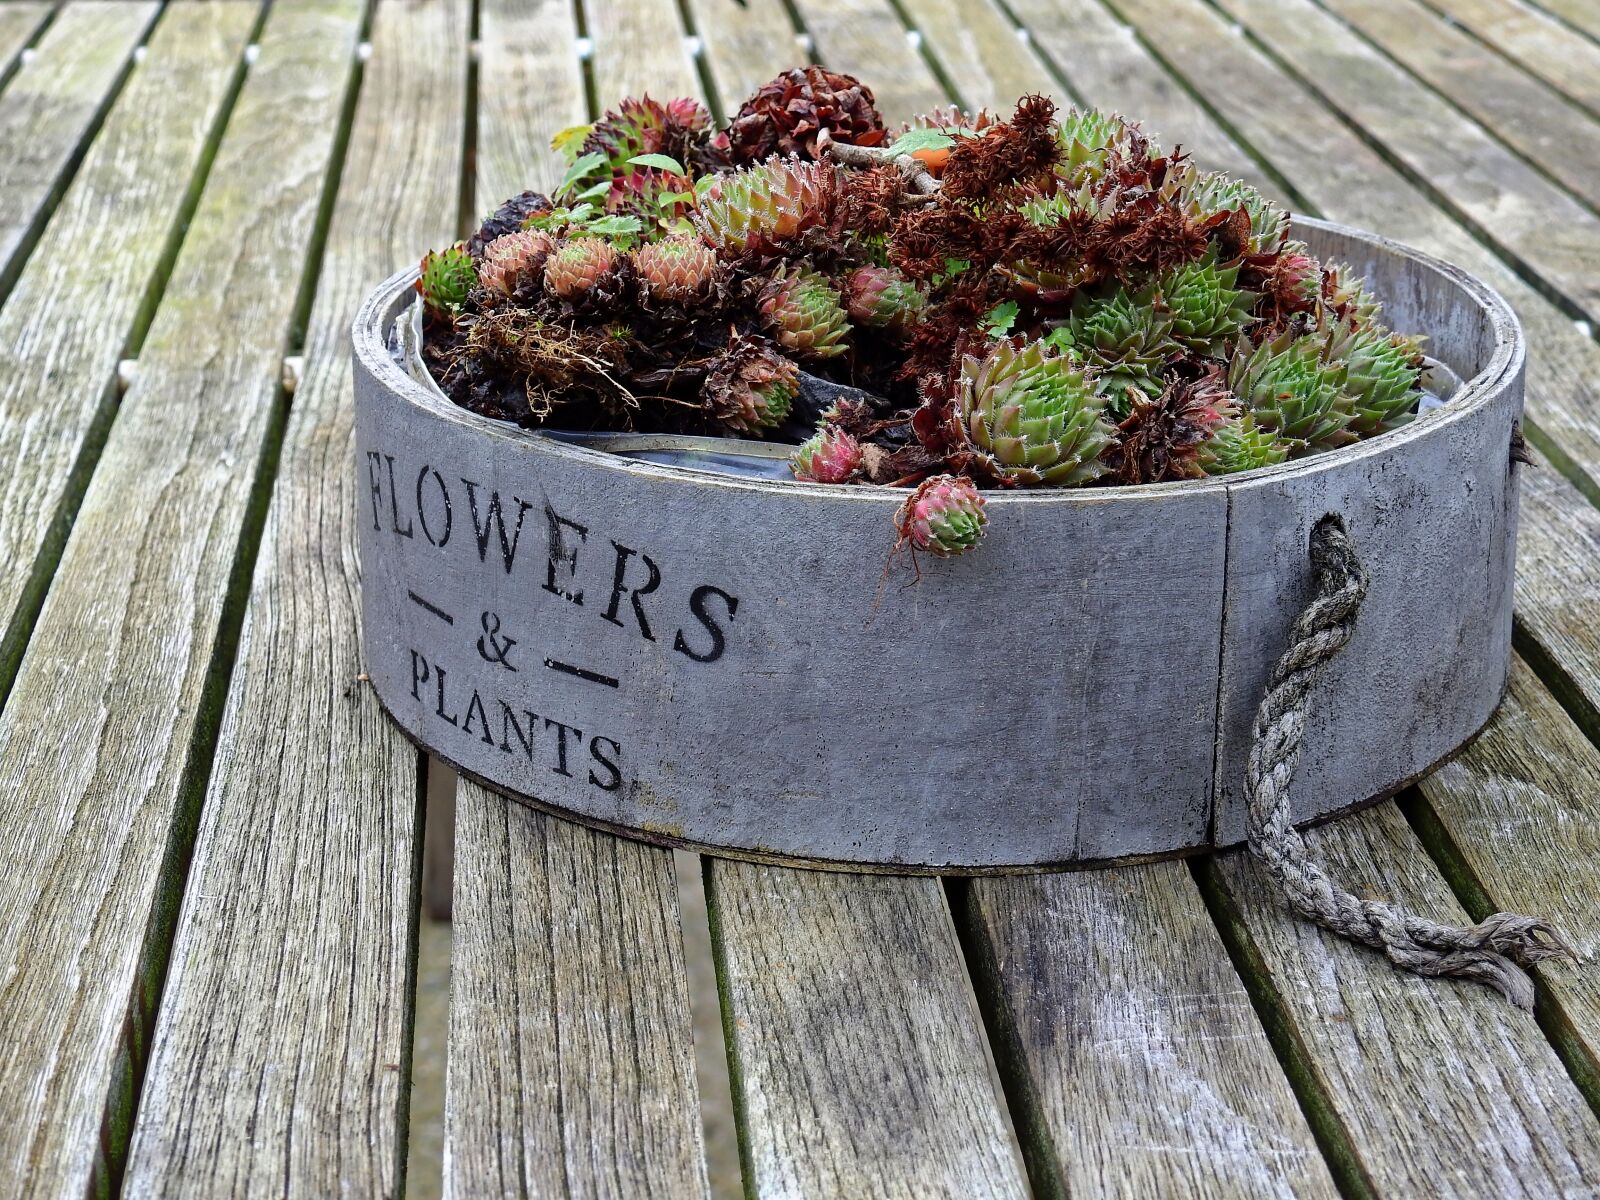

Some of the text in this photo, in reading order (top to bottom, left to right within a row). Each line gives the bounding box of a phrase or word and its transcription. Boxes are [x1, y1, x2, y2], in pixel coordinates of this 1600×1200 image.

[367, 451, 739, 663] FLOWERS
[476, 611, 517, 672] &
[410, 649, 622, 791] PLANTS
